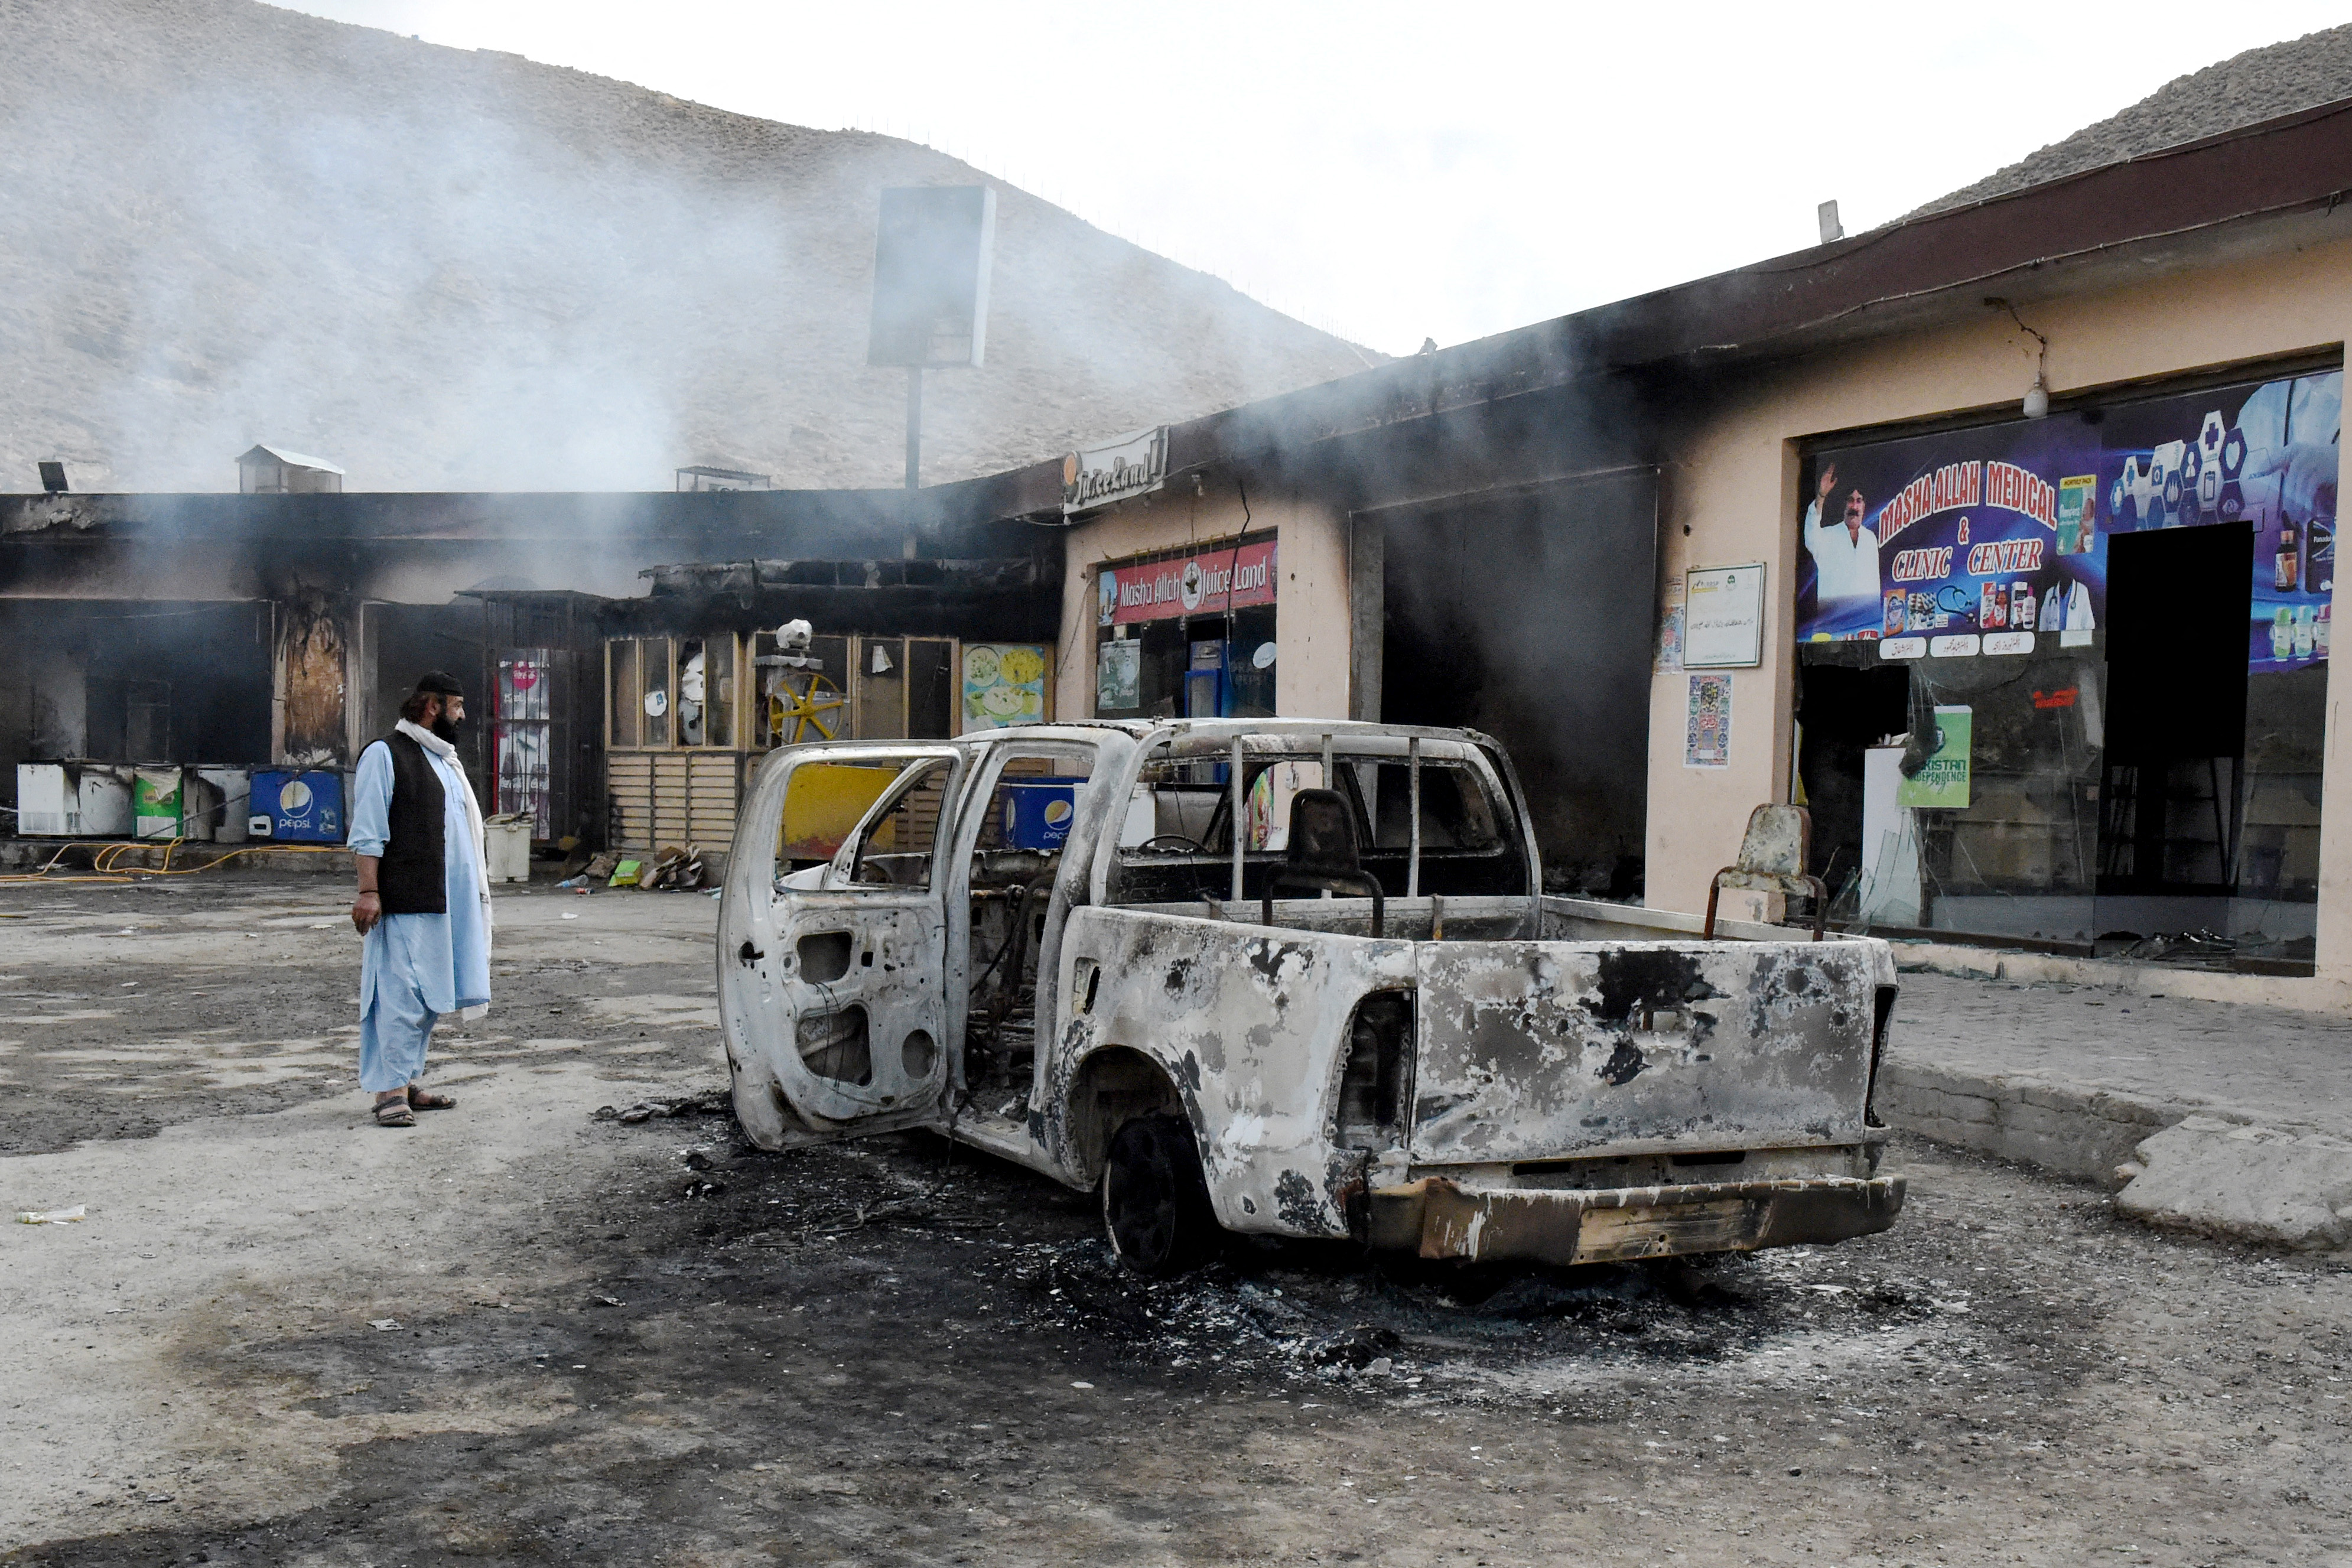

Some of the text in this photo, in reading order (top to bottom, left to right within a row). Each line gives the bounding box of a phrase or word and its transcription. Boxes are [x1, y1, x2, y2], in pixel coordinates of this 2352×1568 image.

[1879, 461, 2057, 548] MASHA ALLAH MEDICAL
[1958, 516, 1969, 545] &
[1120, 577, 1153, 608] Masha
[1201, 564, 1231, 606] Juice
[1234, 556, 1267, 591] Land
[1892, 546, 1953, 582] CLINIC
[1967, 538, 2044, 576] CENTER
[279, 818, 311, 830] pepsi
